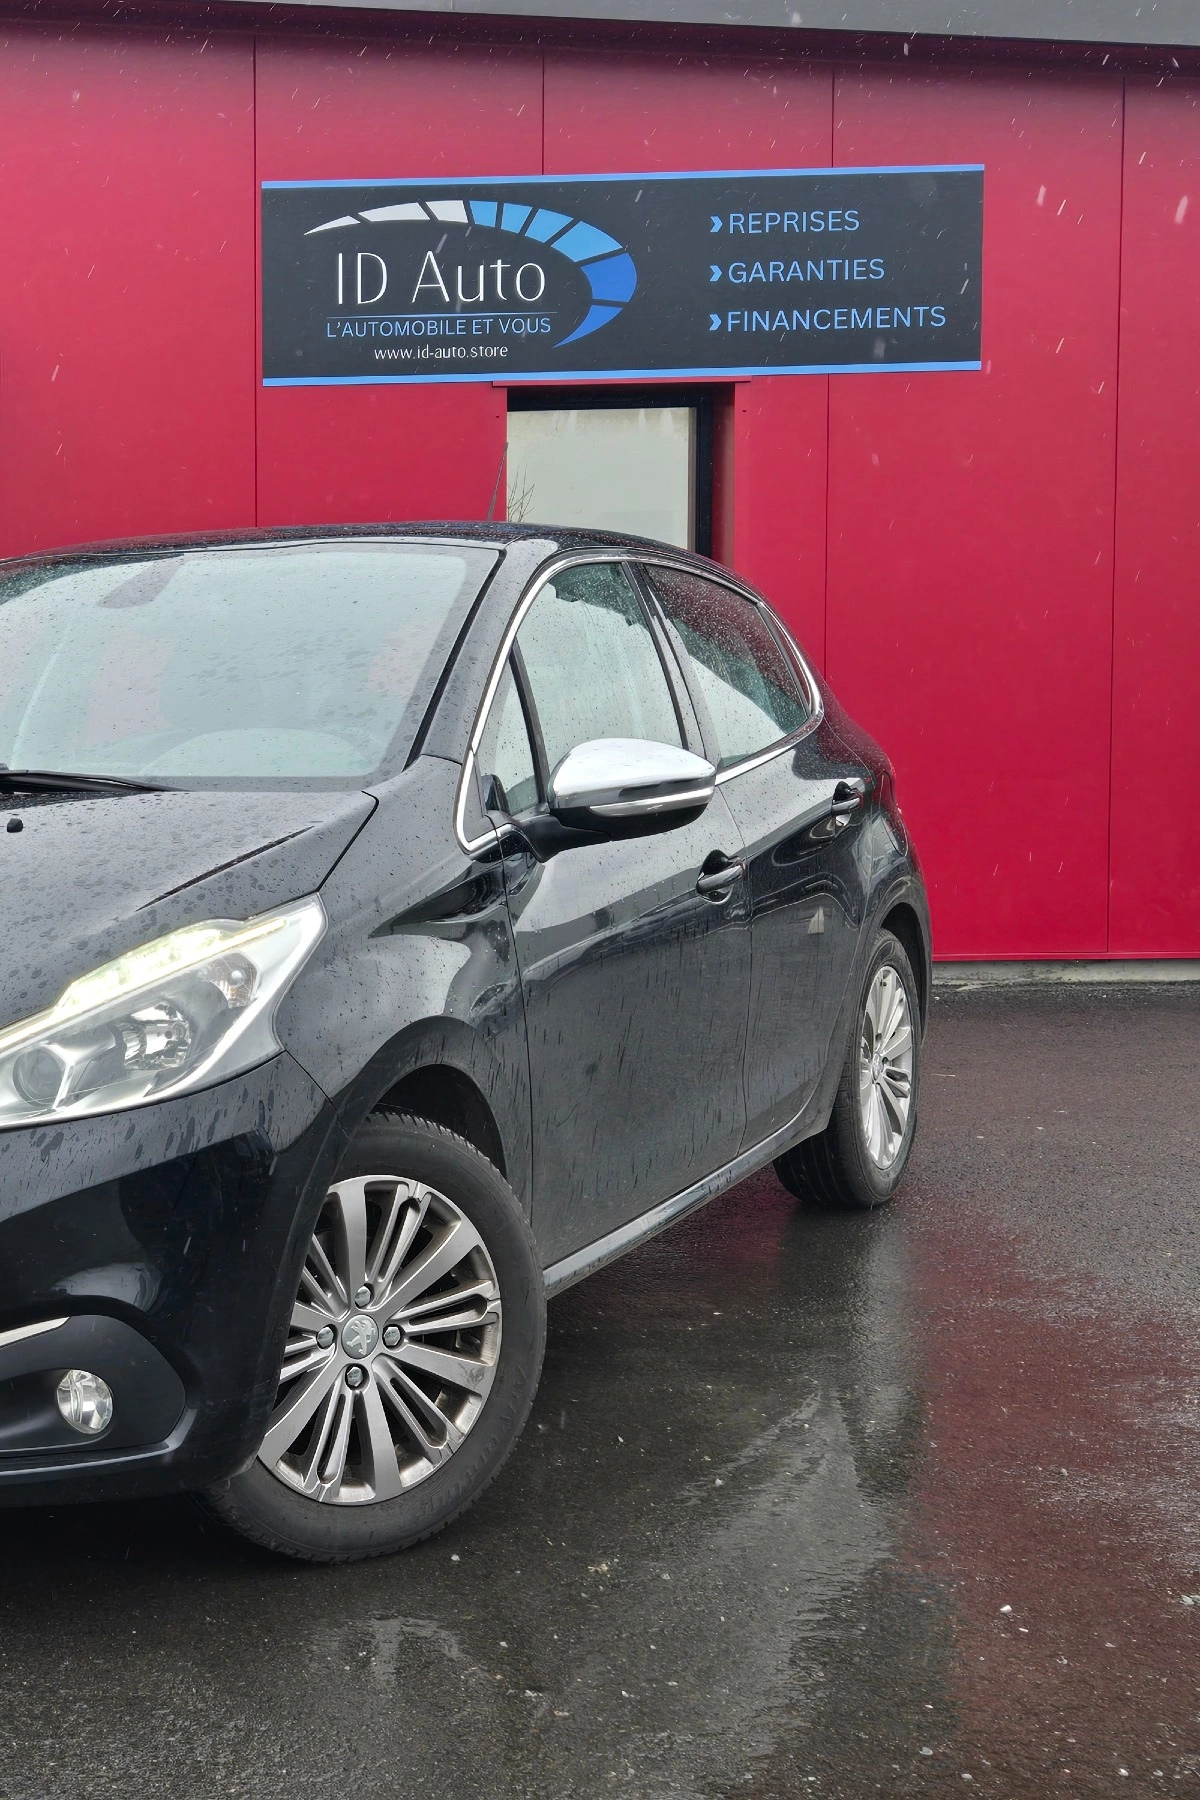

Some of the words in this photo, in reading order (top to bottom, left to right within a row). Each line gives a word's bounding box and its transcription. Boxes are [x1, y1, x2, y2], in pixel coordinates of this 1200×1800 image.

[728, 210, 860, 234] REPRISES
[338, 252, 388, 305] ID
[412, 250, 546, 303] Auto
[728, 258, 885, 284] GARANTIES
[326, 319, 467, 338] L'AUTOMOBILE
[472, 318, 494, 335] ET
[498, 317, 551, 334] VOUS
[727, 306, 946, 332] FINANCEMENTS
[374, 344, 509, 360] www.id-auto.store
